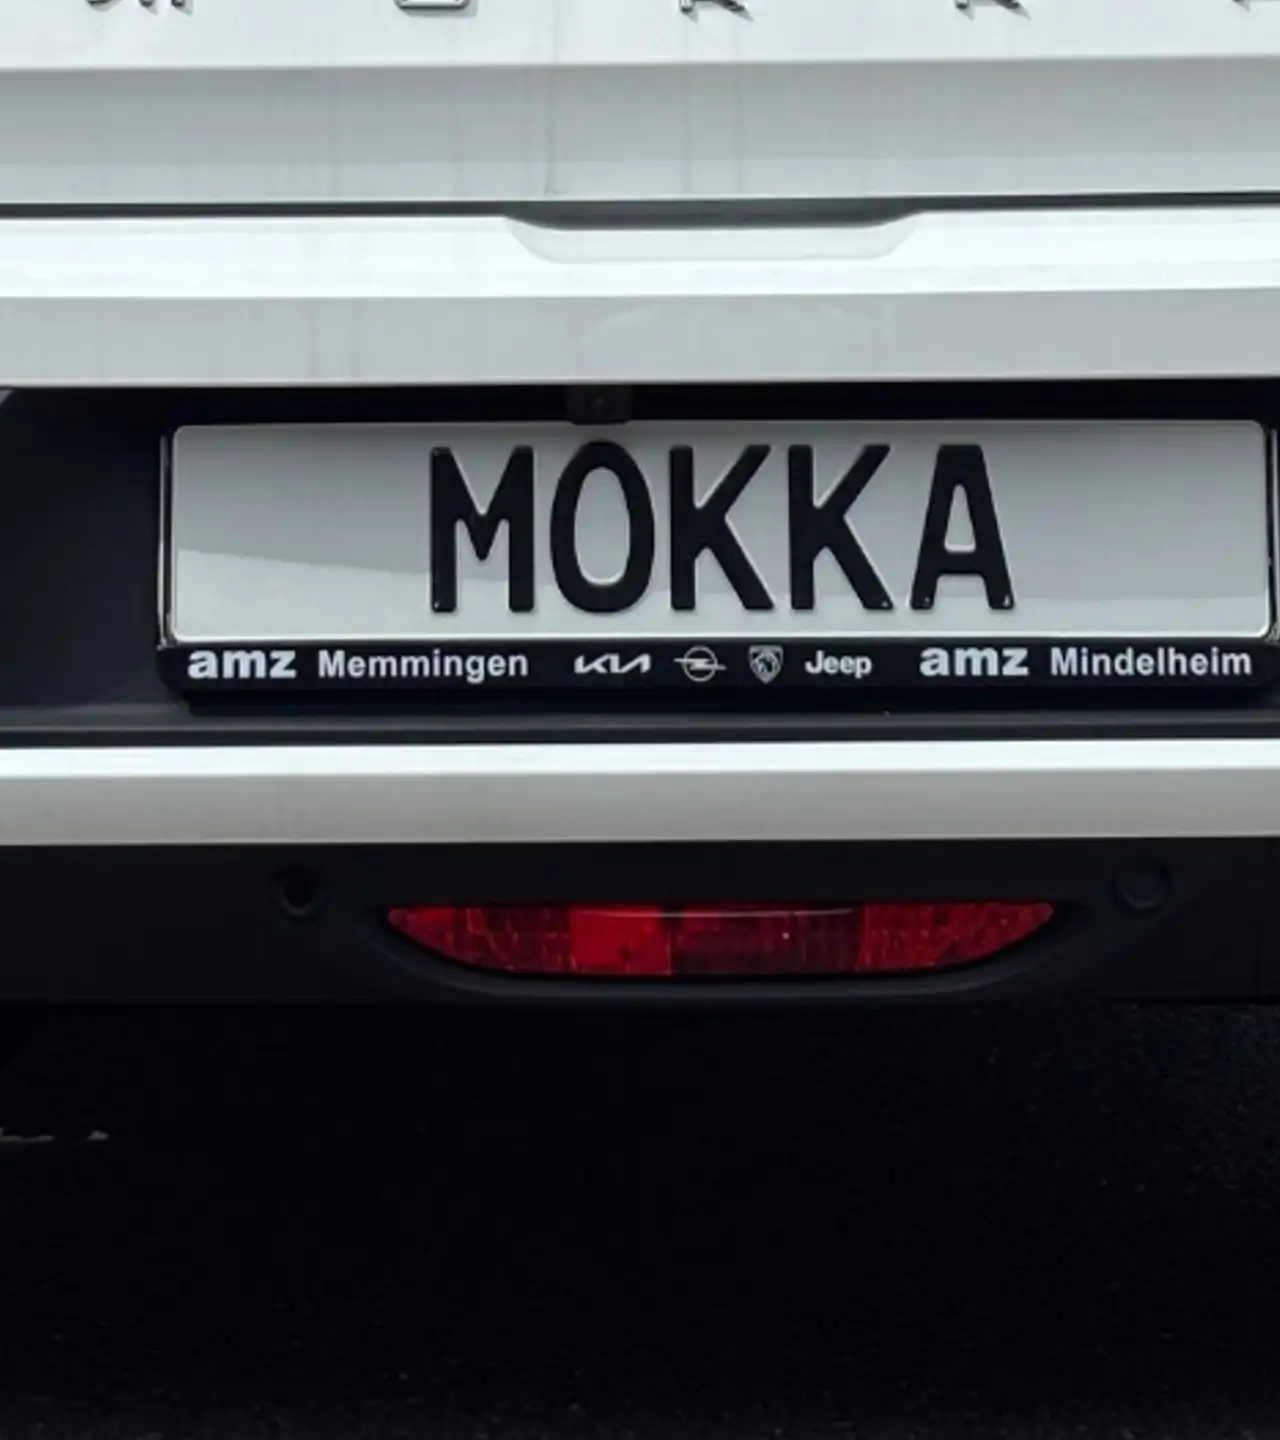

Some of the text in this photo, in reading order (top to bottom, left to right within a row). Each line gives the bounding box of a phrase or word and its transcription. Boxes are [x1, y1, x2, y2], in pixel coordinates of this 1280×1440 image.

[430, 440, 1015, 613] MOKKA
[187, 649, 297, 679] amz
[318, 648, 529, 684] Memmingen
[805, 650, 872, 679] Jeep
[919, 646, 1029, 677] amz
[1050, 646, 1253, 677] Mindelheim
